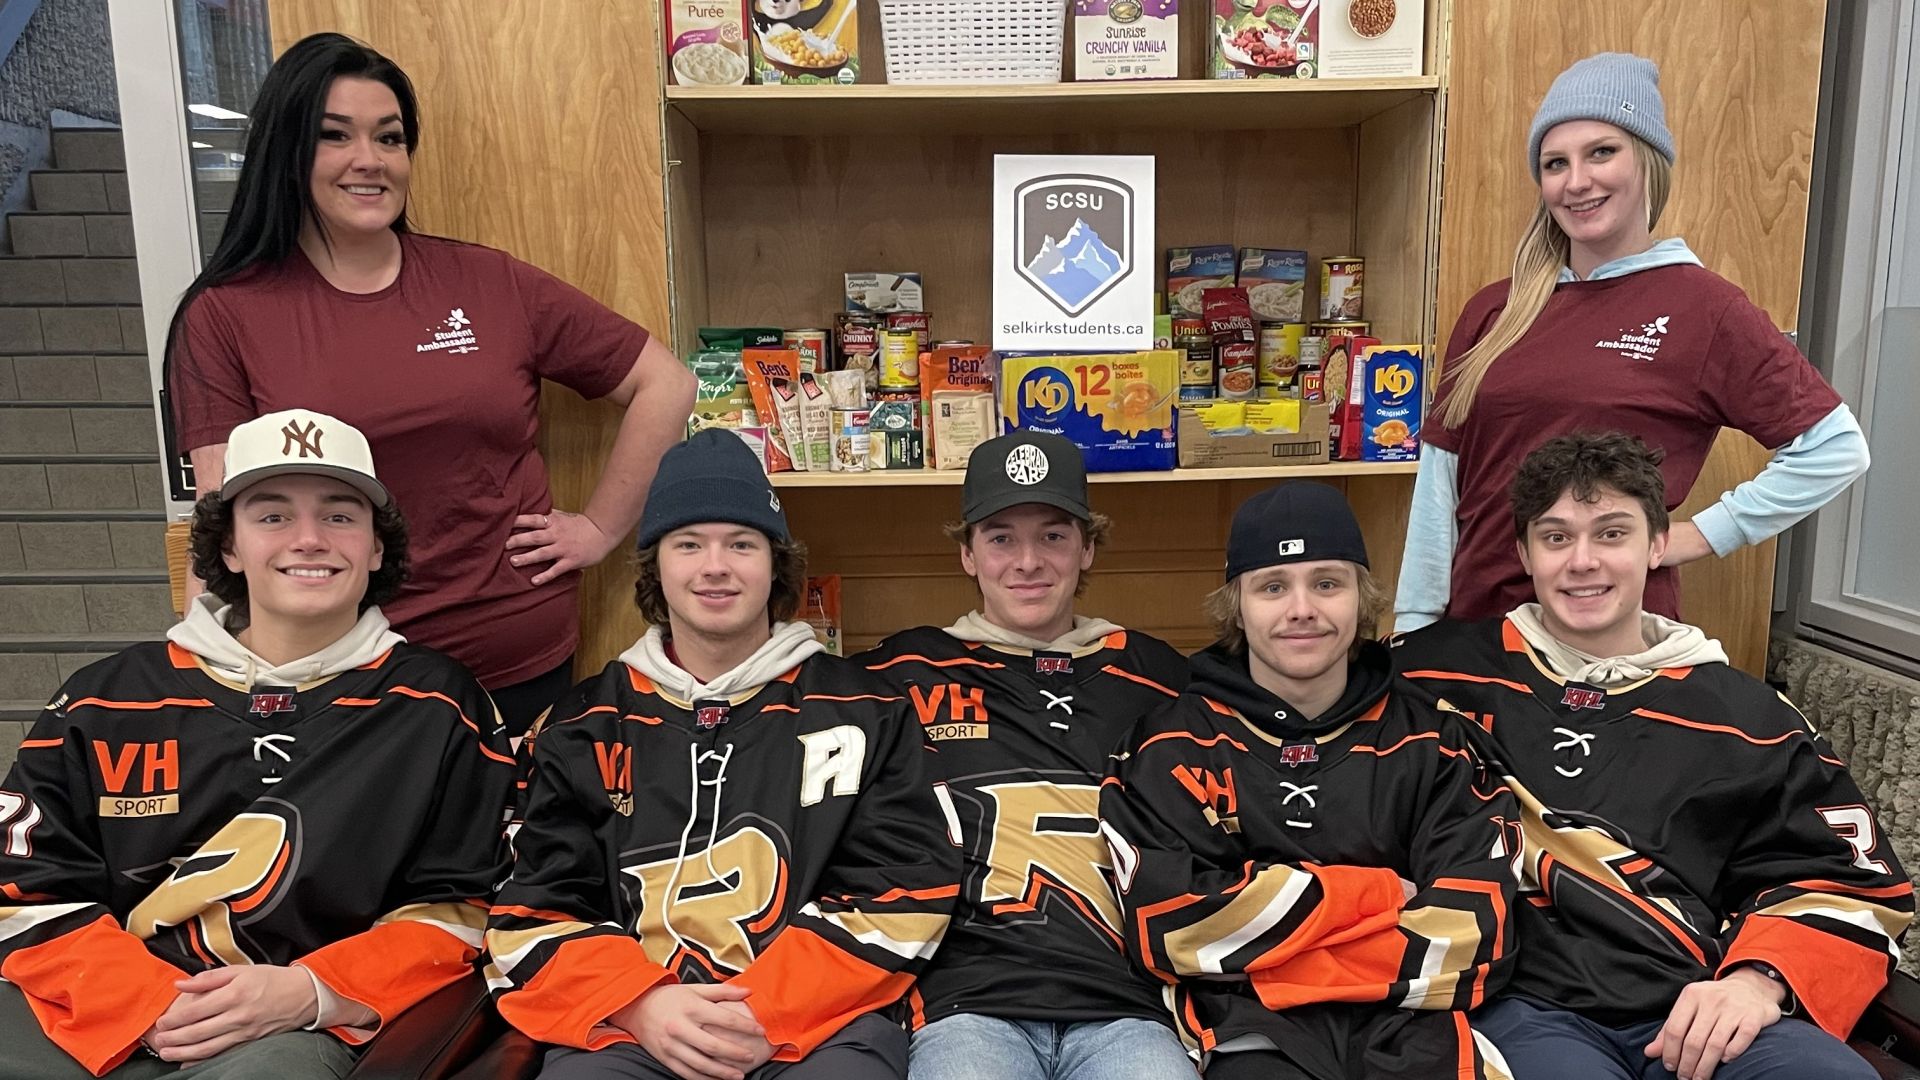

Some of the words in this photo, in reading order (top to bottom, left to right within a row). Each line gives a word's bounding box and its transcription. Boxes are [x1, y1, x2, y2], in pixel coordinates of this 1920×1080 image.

[688, 5, 725, 18] Purée
[1085, 41, 1129, 55] CRUNCHY
[1046, 192, 1103, 211] SCSU
[434, 328, 474, 341] Student
[1003, 321, 1144, 335] selkirkstudents.ca
[1175, 325, 1207, 337] Unico
[416, 337, 476, 352] Ambassador
[843, 334, 873, 343] CHUNKY
[1621, 334, 1661, 346] Student
[1595, 341, 1659, 354] Ambassador
[756, 360, 790, 376] Ben's
[948, 355, 989, 373] Ben'
[1112, 362, 1139, 371] boxes
[1075, 364, 1111, 396] 12
[1115, 370, 1143, 379] boîtes
[1375, 364, 1414, 398] KD
[700, 380, 733, 393] Knorr
[1025, 376, 1069, 415] KD
[1376, 408, 1410, 418] ORIGINAL
[908, 683, 989, 724] VH
[927, 725, 977, 740] SPORT
[93, 739, 179, 793] VH
[797, 725, 867, 807] A
[1170, 764, 1237, 815] VH
[114, 798, 167, 815] SPORT
